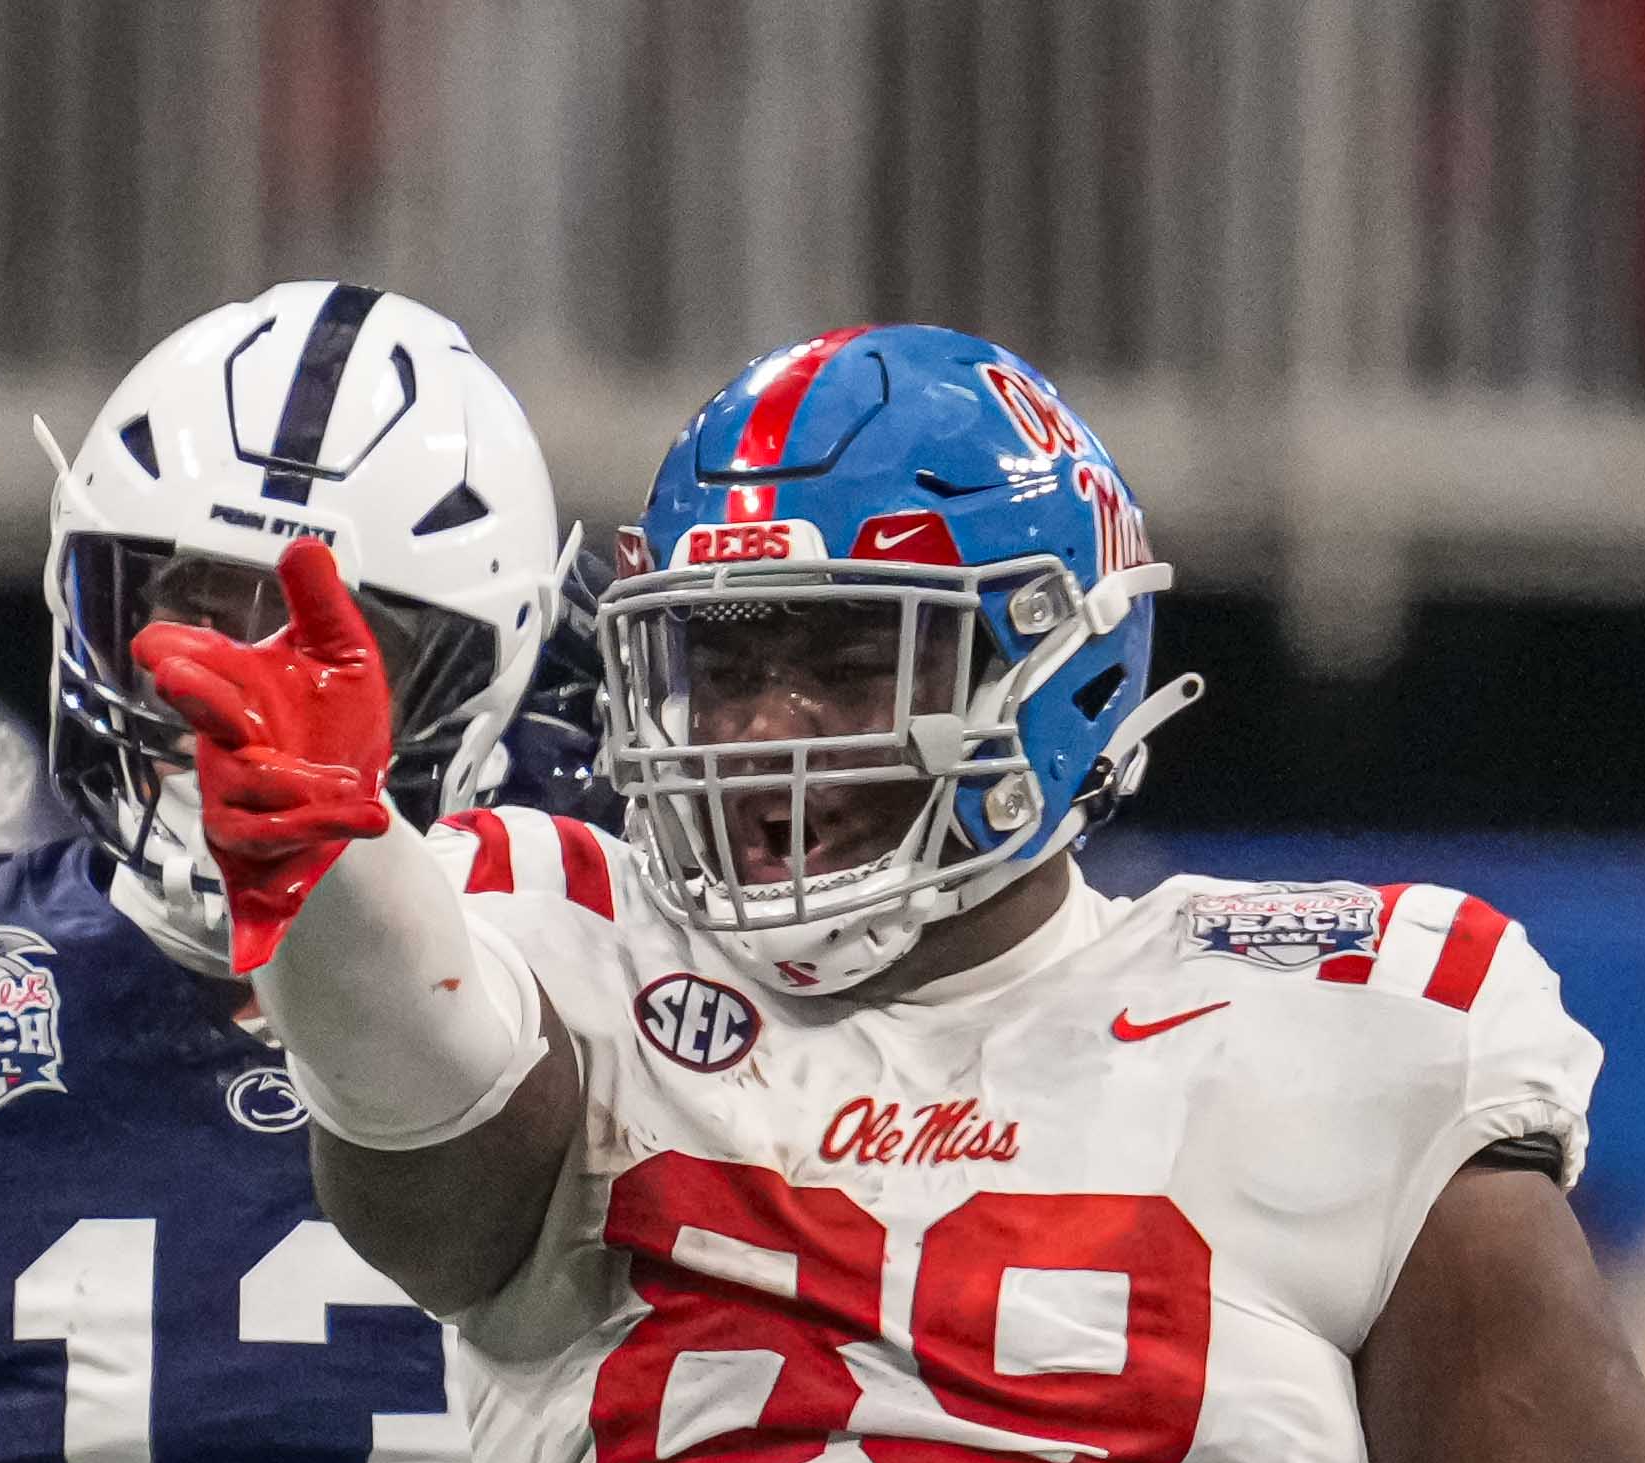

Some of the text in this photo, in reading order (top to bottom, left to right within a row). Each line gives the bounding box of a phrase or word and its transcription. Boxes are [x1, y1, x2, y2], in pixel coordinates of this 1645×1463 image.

[688, 525, 791, 565] REBS
[1195, 909, 1374, 936] PEACH
[644, 979, 749, 1065] SEC
[819, 1097, 1021, 1166] Ole Miss
